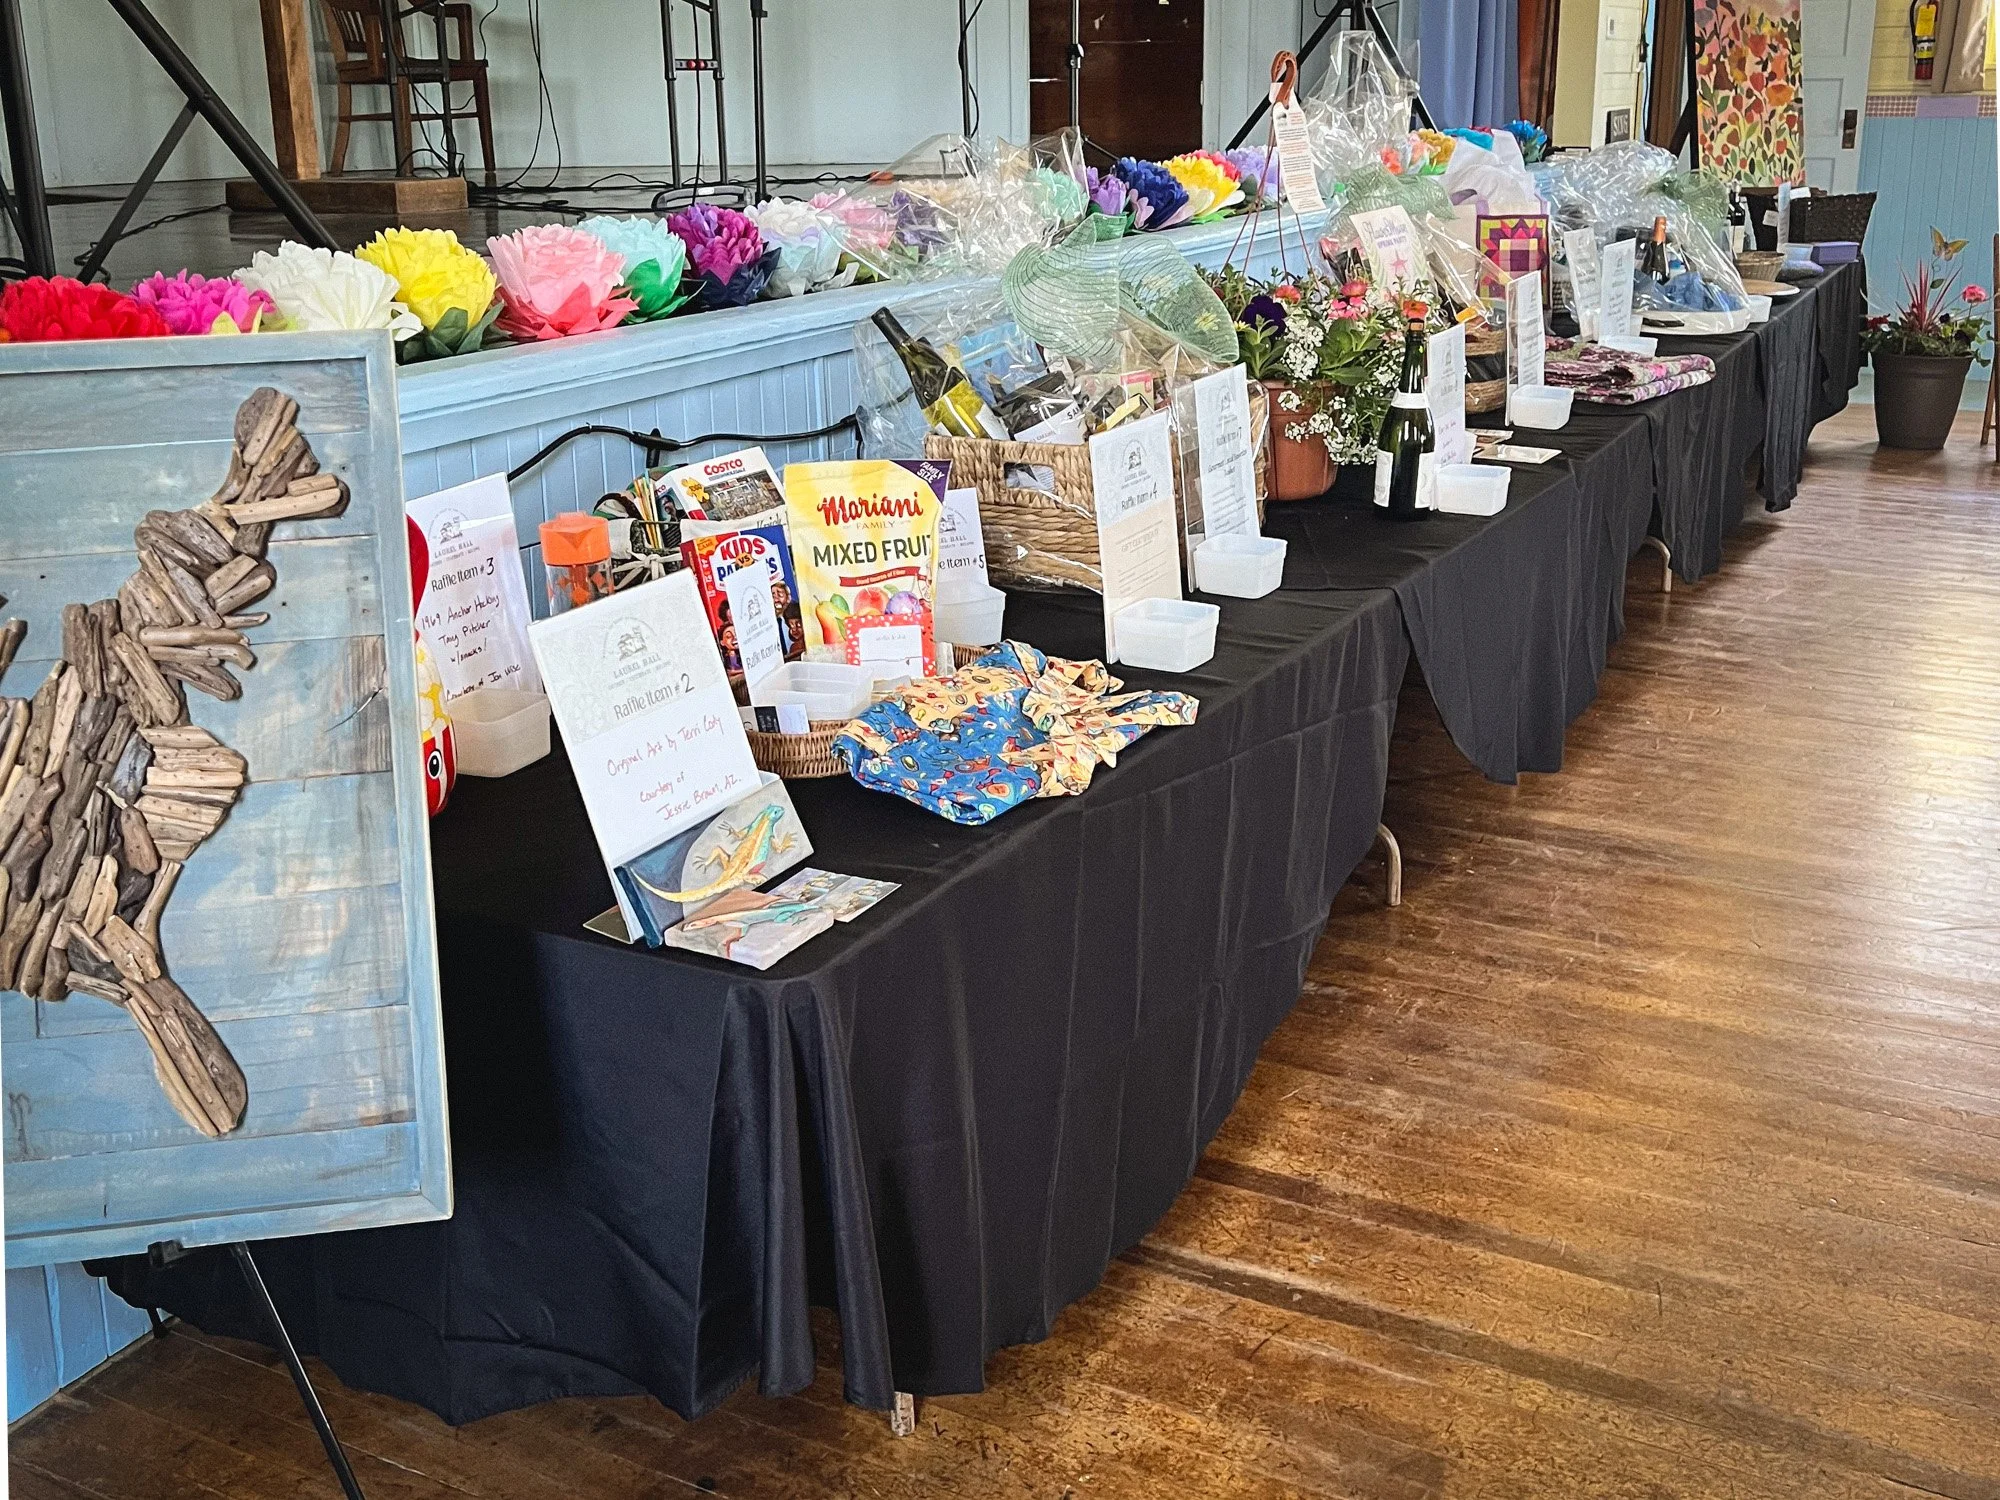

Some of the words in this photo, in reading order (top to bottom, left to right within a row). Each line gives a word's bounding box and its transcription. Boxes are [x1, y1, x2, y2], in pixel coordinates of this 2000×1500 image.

[703, 458, 743, 476] COSTCO
[917, 469, 936, 484] SIZE
[919, 461, 945, 480] FAMILY
[817, 491, 924, 527] Mariani
[856, 520, 896, 530] FAMILY
[720, 537, 766, 561] KIDS
[813, 541, 878, 568] MIXED
[882, 534, 931, 561] FRUI
[738, 555, 751, 565] VS
[431, 573, 457, 592] Raffle
[456, 566, 479, 582] Item
[422, 612, 442, 631] 1969
[447, 606, 472, 624] Anchor
[462, 620, 491, 637] Pitcher
[613, 696, 647, 720] Raffle
[645, 685, 674, 706] Item
[607, 749, 643, 776] Original
[646, 741, 663, 758] Art
[665, 734, 677, 752] by
[677, 723, 701, 742] Terri
[676, 771, 685, 782] of
[656, 803, 691, 821] Jessie
